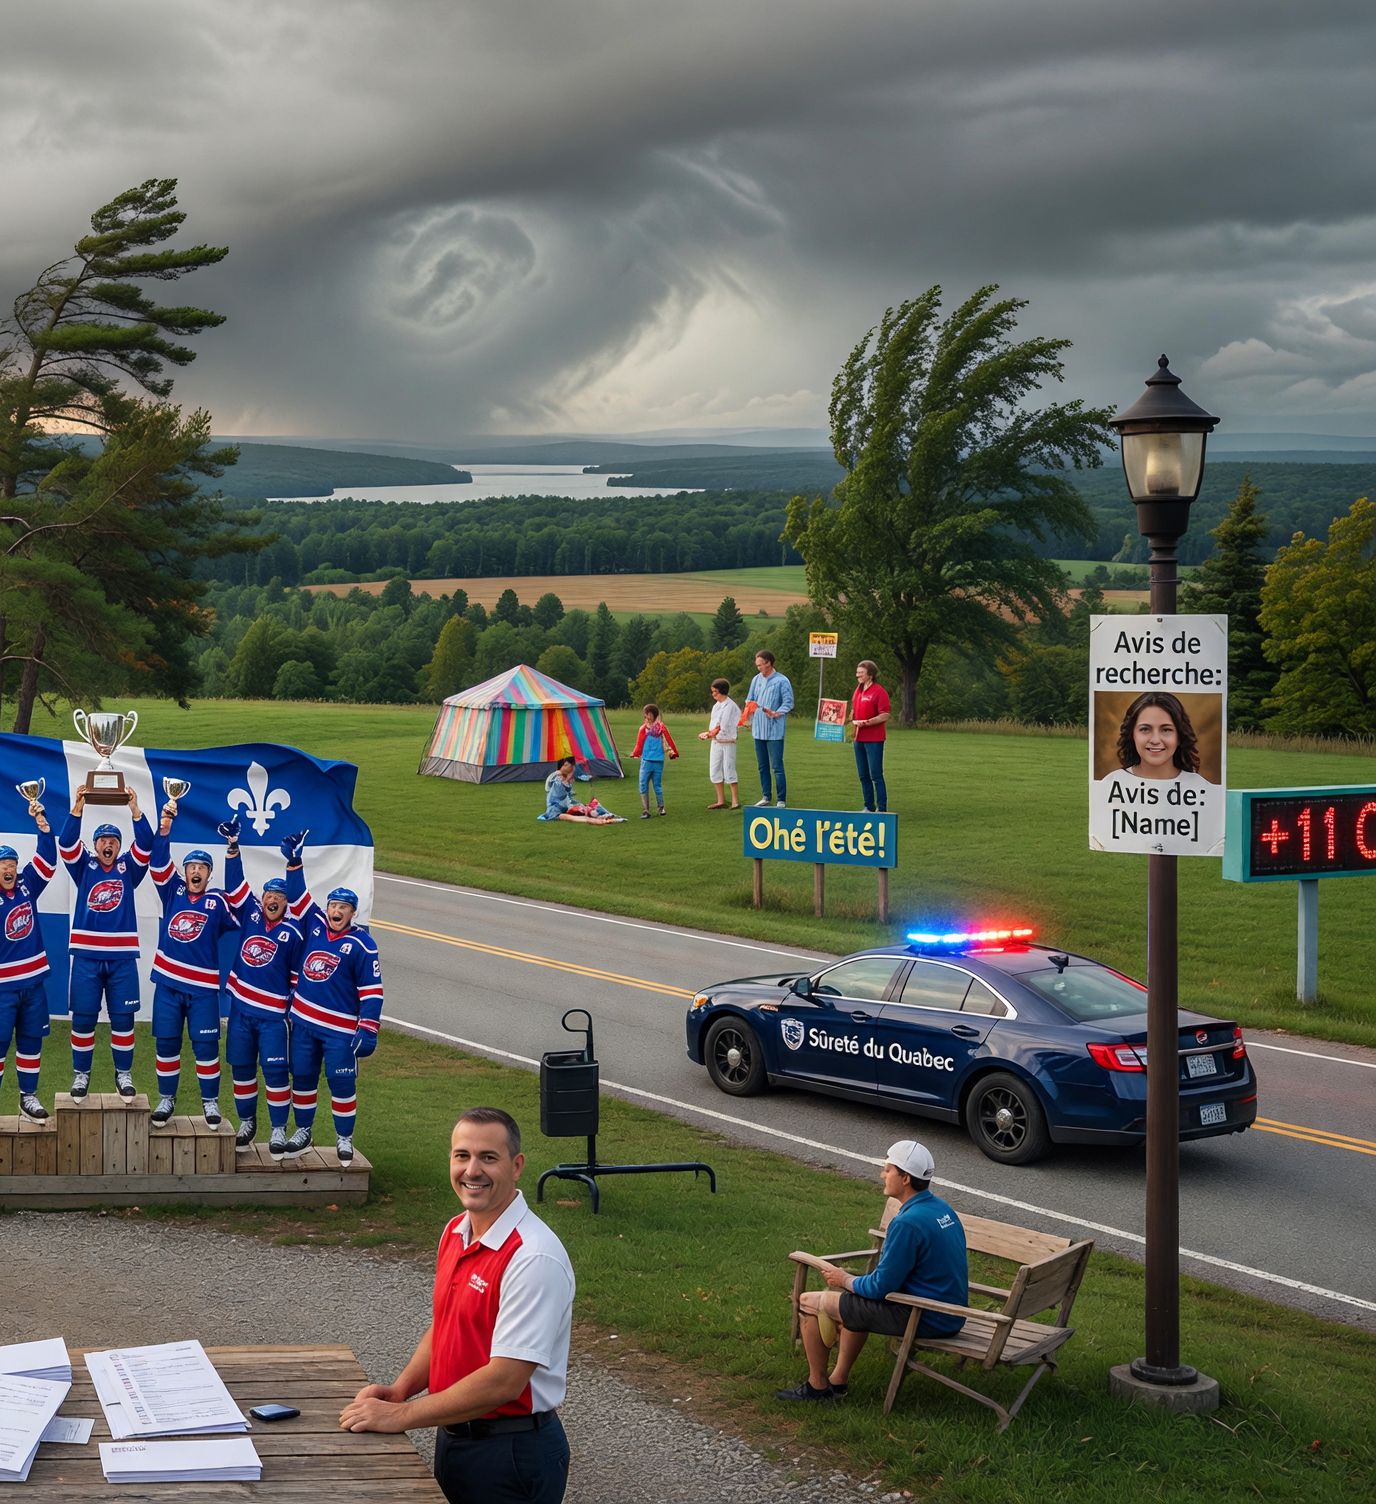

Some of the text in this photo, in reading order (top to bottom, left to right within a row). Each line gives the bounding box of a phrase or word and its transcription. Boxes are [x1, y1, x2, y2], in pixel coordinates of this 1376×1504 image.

[1114, 631, 1201, 654] Avis de
[1096, 661, 1222, 686] recherche:
[1108, 781, 1206, 807] Avis de:
[749, 816, 886, 858] Ohé l'été!
[1112, 809, 1199, 842] [Name]
[808, 1027, 860, 1055] Sûreté
[863, 1037, 884, 1060] du
